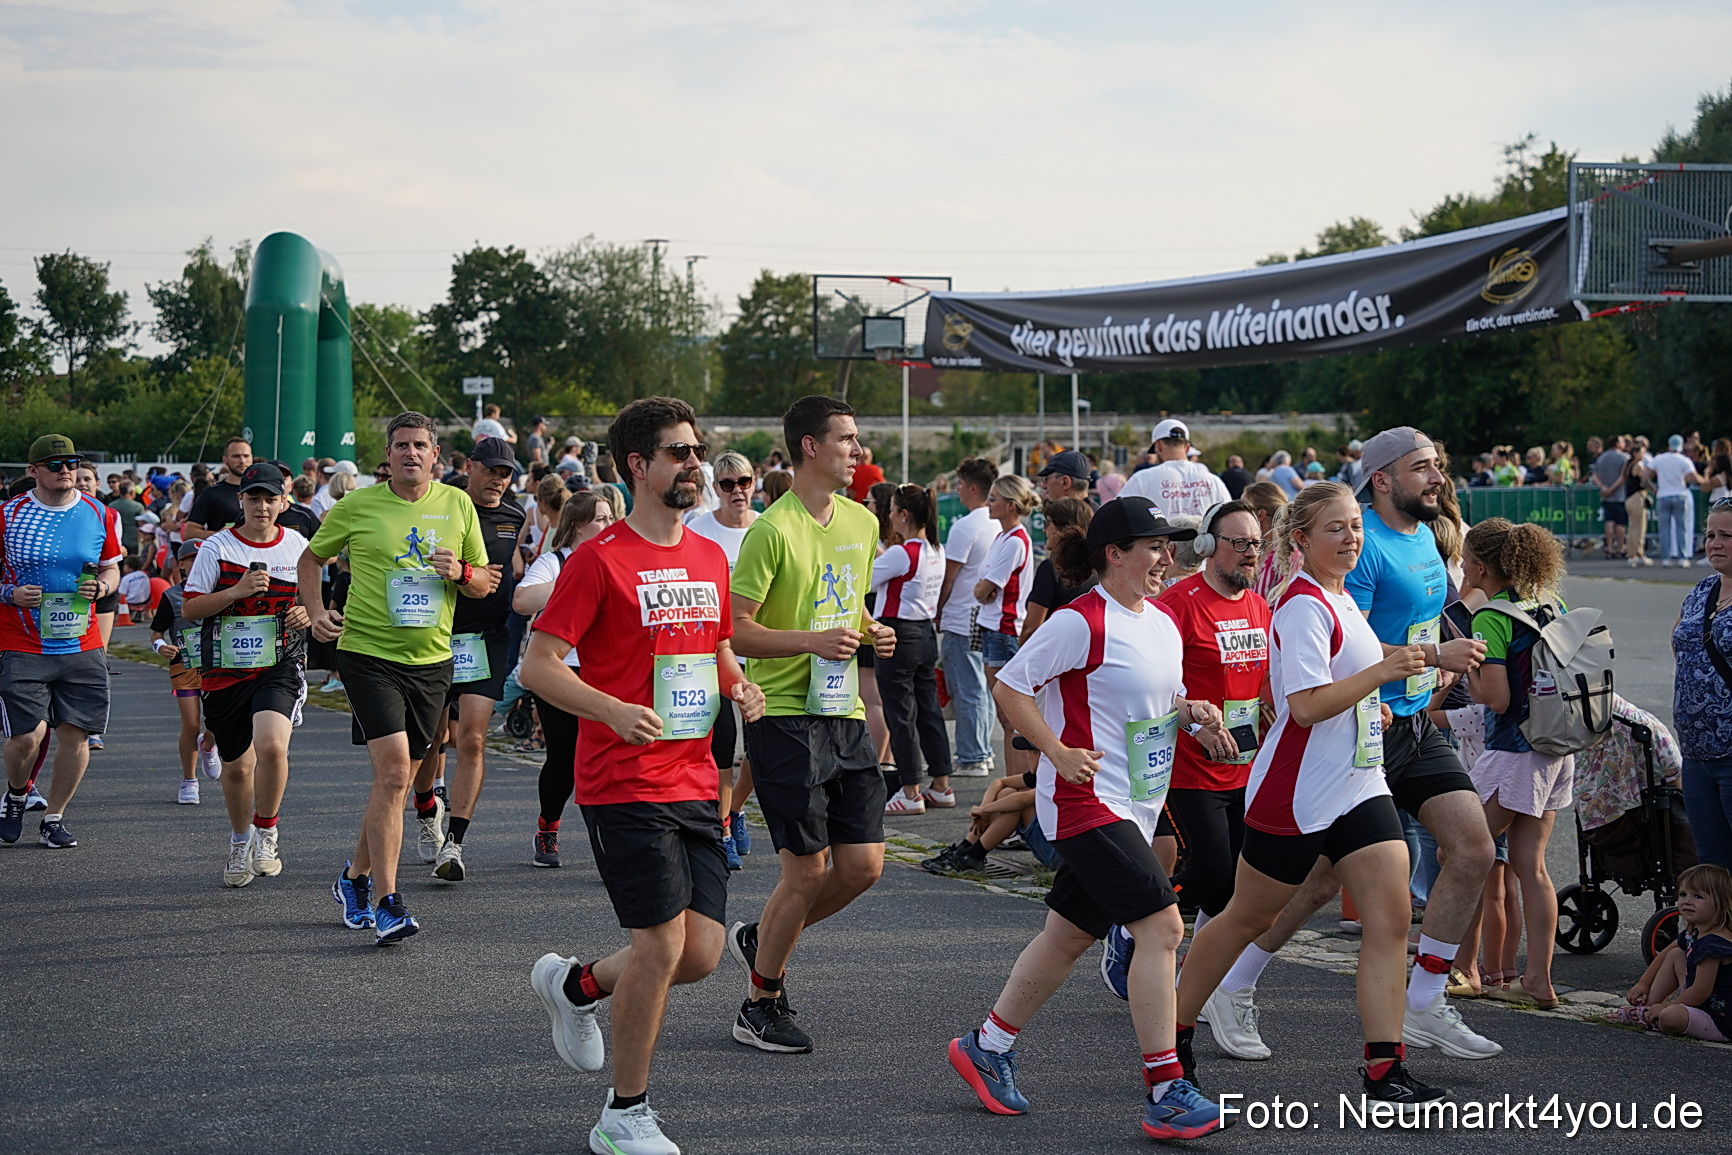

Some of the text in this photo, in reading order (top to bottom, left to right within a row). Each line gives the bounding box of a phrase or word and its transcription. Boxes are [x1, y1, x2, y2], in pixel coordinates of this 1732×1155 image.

[1466, 318, 1478, 332] Ein
[1496, 314, 1511, 327] der
[1512, 307, 1559, 325] verbindet.
[1010, 290, 1405, 367] Hier gewinnt das Miteinander.
[300, 431, 315, 446] AO
[340, 431, 355, 446] AO
[1181, 480, 1213, 491] Sunday
[1162, 490, 1191, 499] Coffee
[835, 543, 860, 553] BERATA
[637, 568, 674, 583] TEAM
[402, 594, 429, 606] 235
[643, 584, 718, 610] LÖWEN
[648, 607, 719, 623] APOTHEKEN
[1214, 619, 1240, 631] TEAM
[232, 638, 263, 648] 2612
[1221, 632, 1266, 652] LÖWEN
[452, 654, 473, 665] 254
[1225, 649, 1267, 661] APOTHEKE
[827, 675, 845, 689] 227
[671, 689, 706, 707] 1523
[669, 711, 700, 719] Konstantin
[1370, 720, 1383, 737] 56
[1148, 746, 1172, 768] 536
[1143, 768, 1165, 780] Susanne
